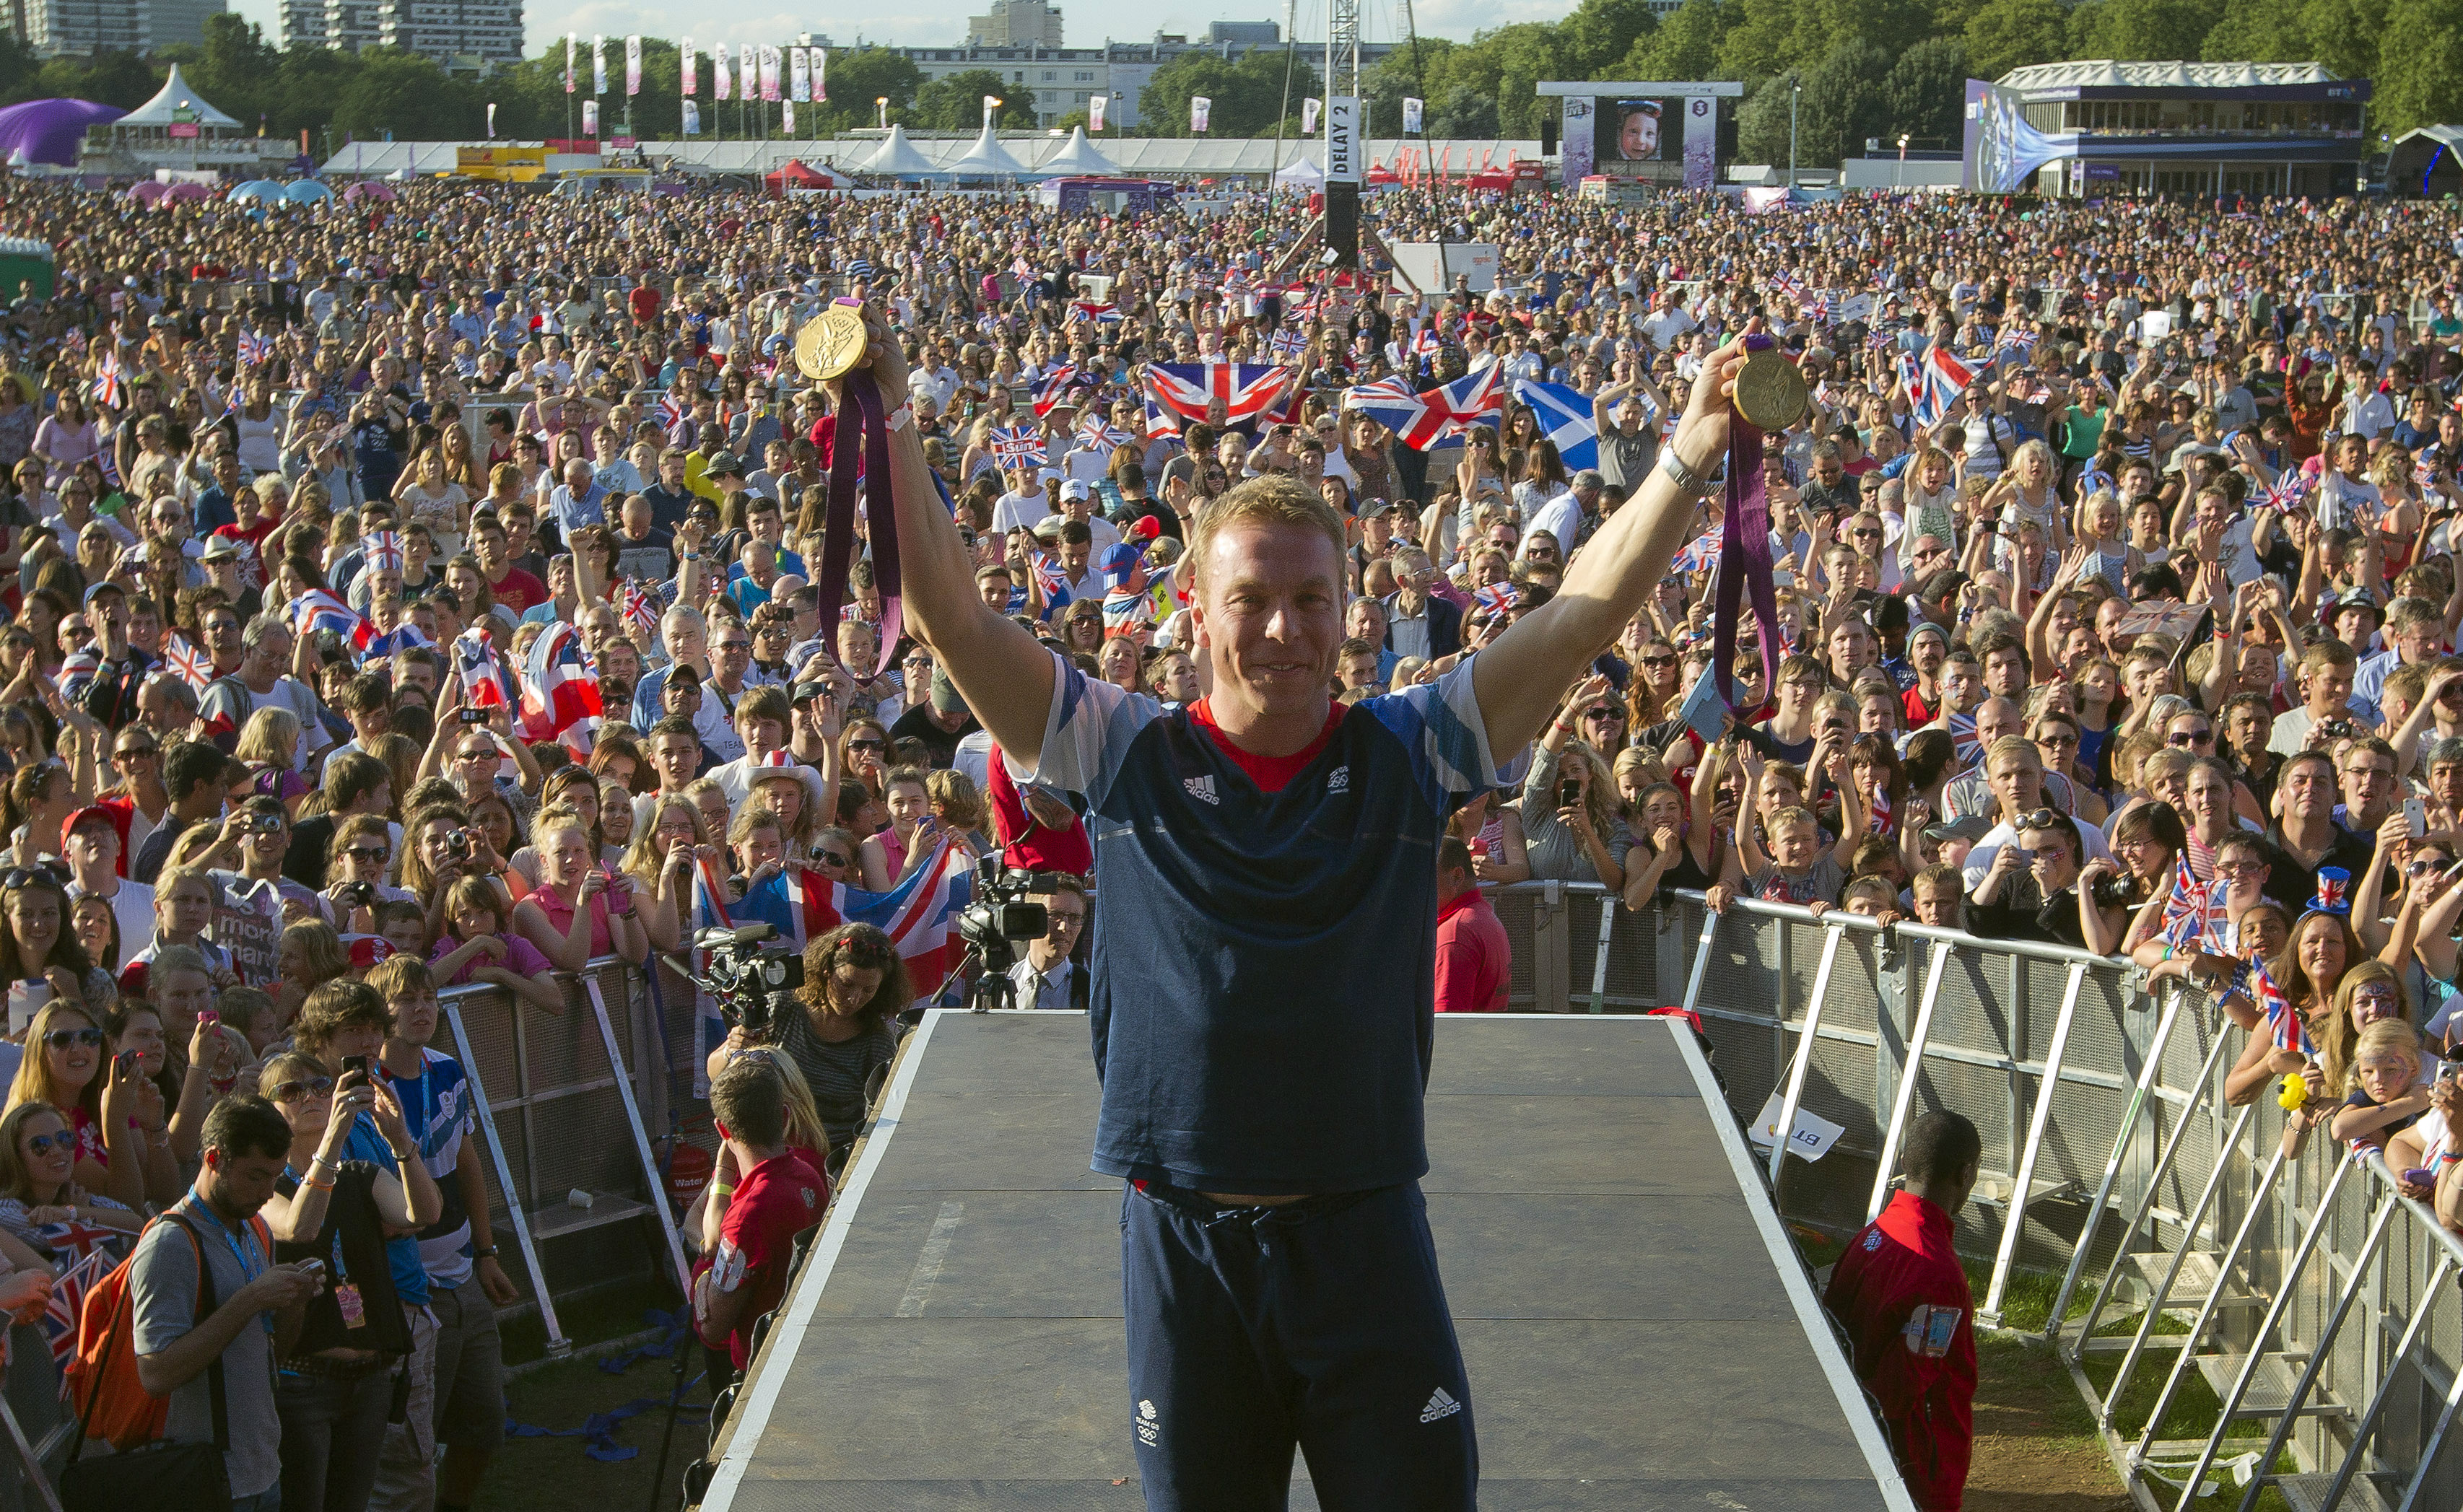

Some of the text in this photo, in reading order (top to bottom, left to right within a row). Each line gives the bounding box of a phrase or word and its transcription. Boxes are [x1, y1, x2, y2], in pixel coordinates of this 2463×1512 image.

[1333, 105, 1348, 173] DELAY 2
[1006, 442, 1034, 453] Sun
[1792, 1129, 1821, 1146] BT
[675, 1178, 703, 1187] Water
[1420, 1402, 1461, 1423] adidas
